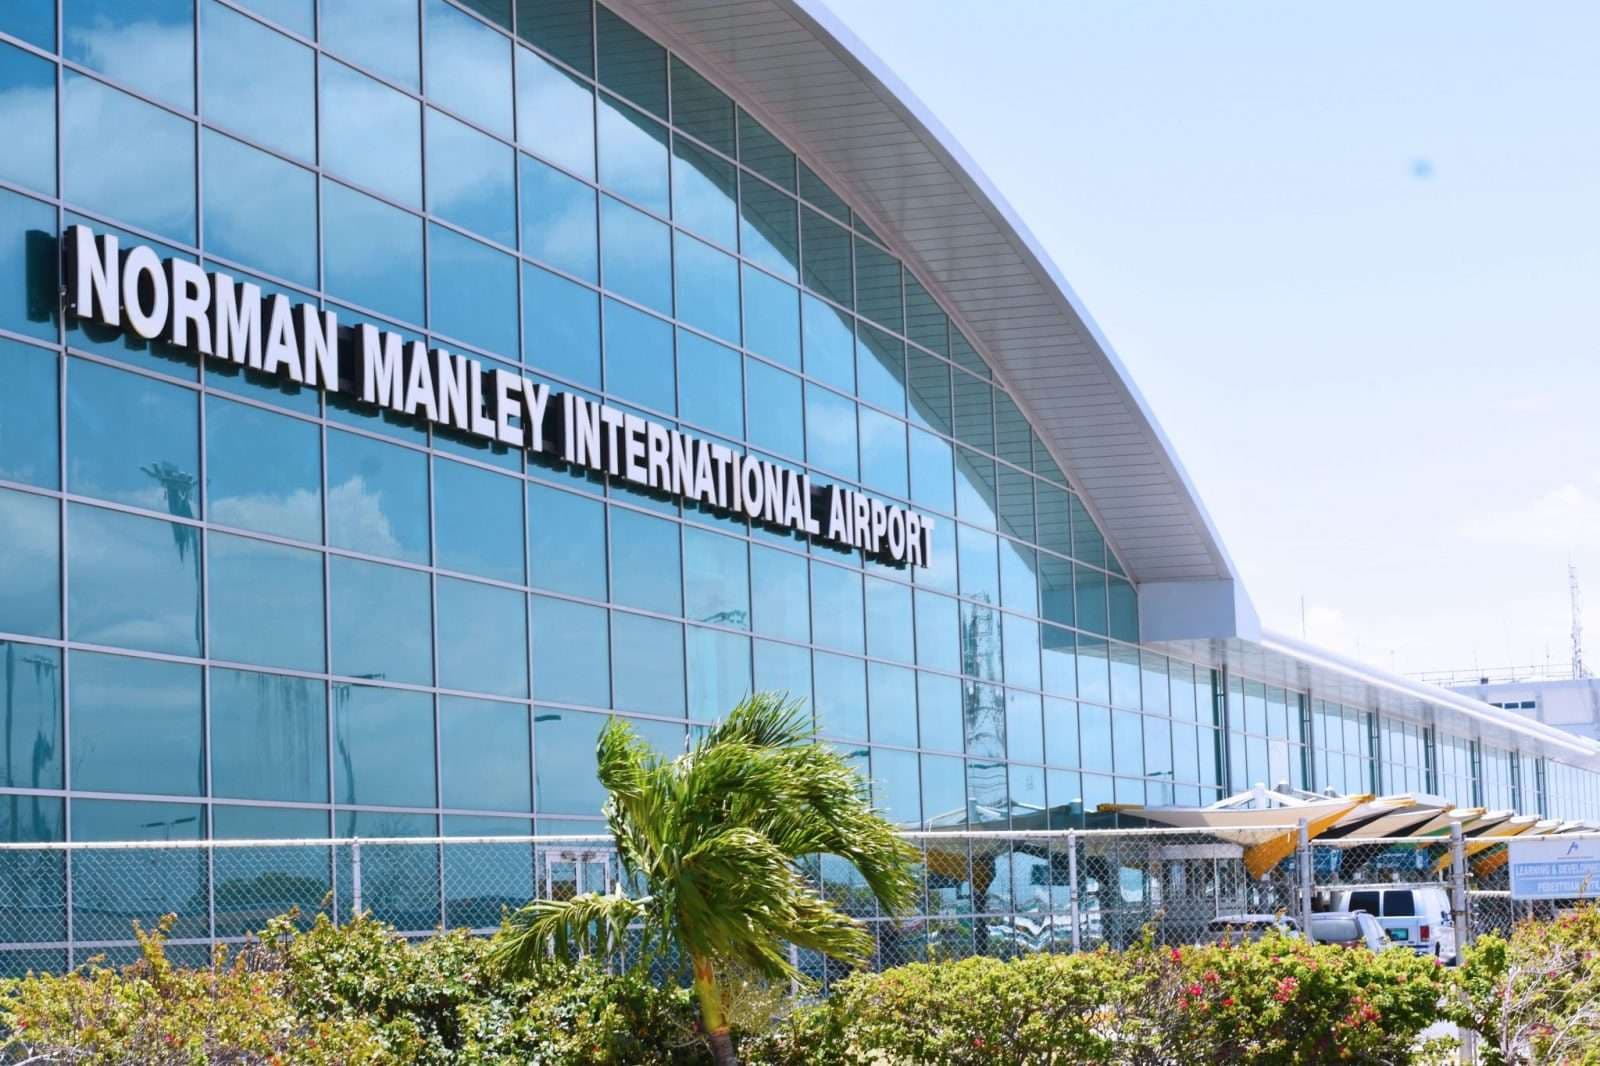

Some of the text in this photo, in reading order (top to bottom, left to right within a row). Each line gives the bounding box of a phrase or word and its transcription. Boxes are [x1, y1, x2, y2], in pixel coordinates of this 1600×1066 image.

[75, 224, 935, 569] NORMAN MANLEY INTERNATIONAL AIRPORT
